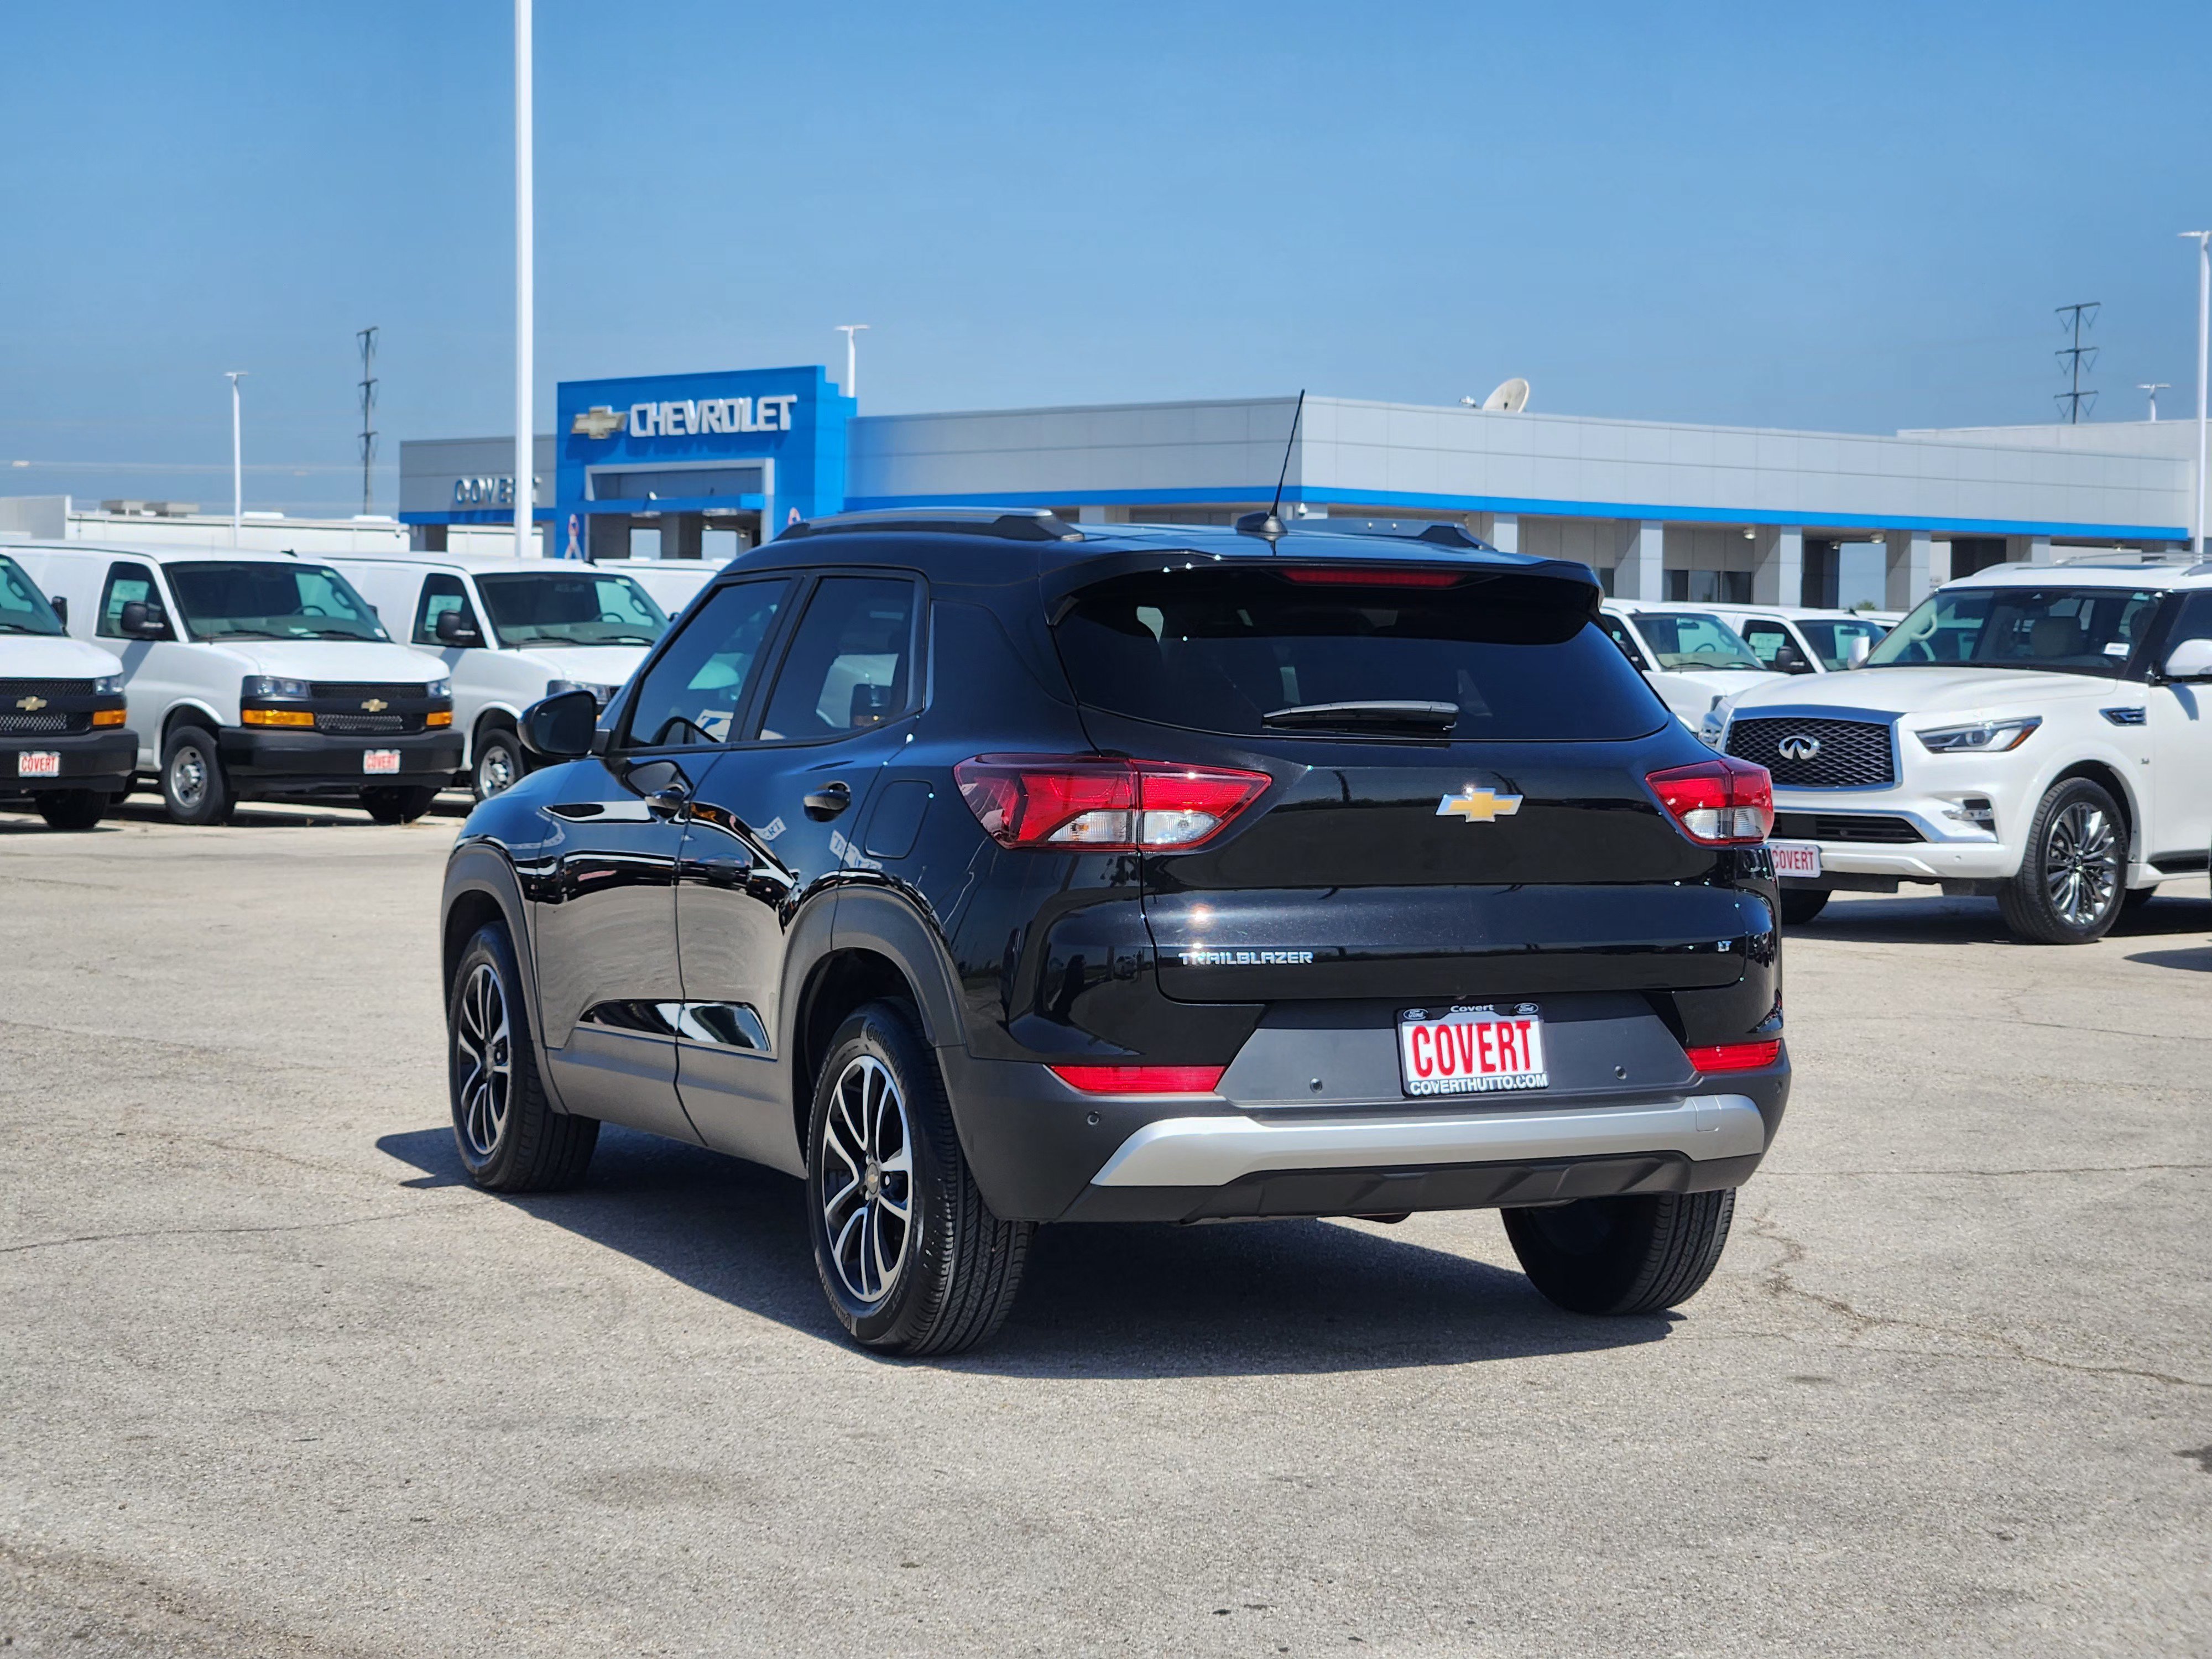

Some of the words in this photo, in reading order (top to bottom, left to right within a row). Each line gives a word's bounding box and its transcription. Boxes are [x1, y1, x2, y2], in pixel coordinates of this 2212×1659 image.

[630, 395, 797, 437] CHEVROLET
[455, 477, 542, 504] COVE
[22, 756, 56, 772] COVERT
[1772, 850, 1813, 870] COVERT
[1717, 941, 1732, 952] LT
[1178, 951, 1313, 964] TRAILBLAZER
[1450, 1004, 1494, 1013] Covert
[1412, 1020, 1532, 1078] COVERT
[1410, 1073, 1548, 1096] COVERTHUTTO.COM
